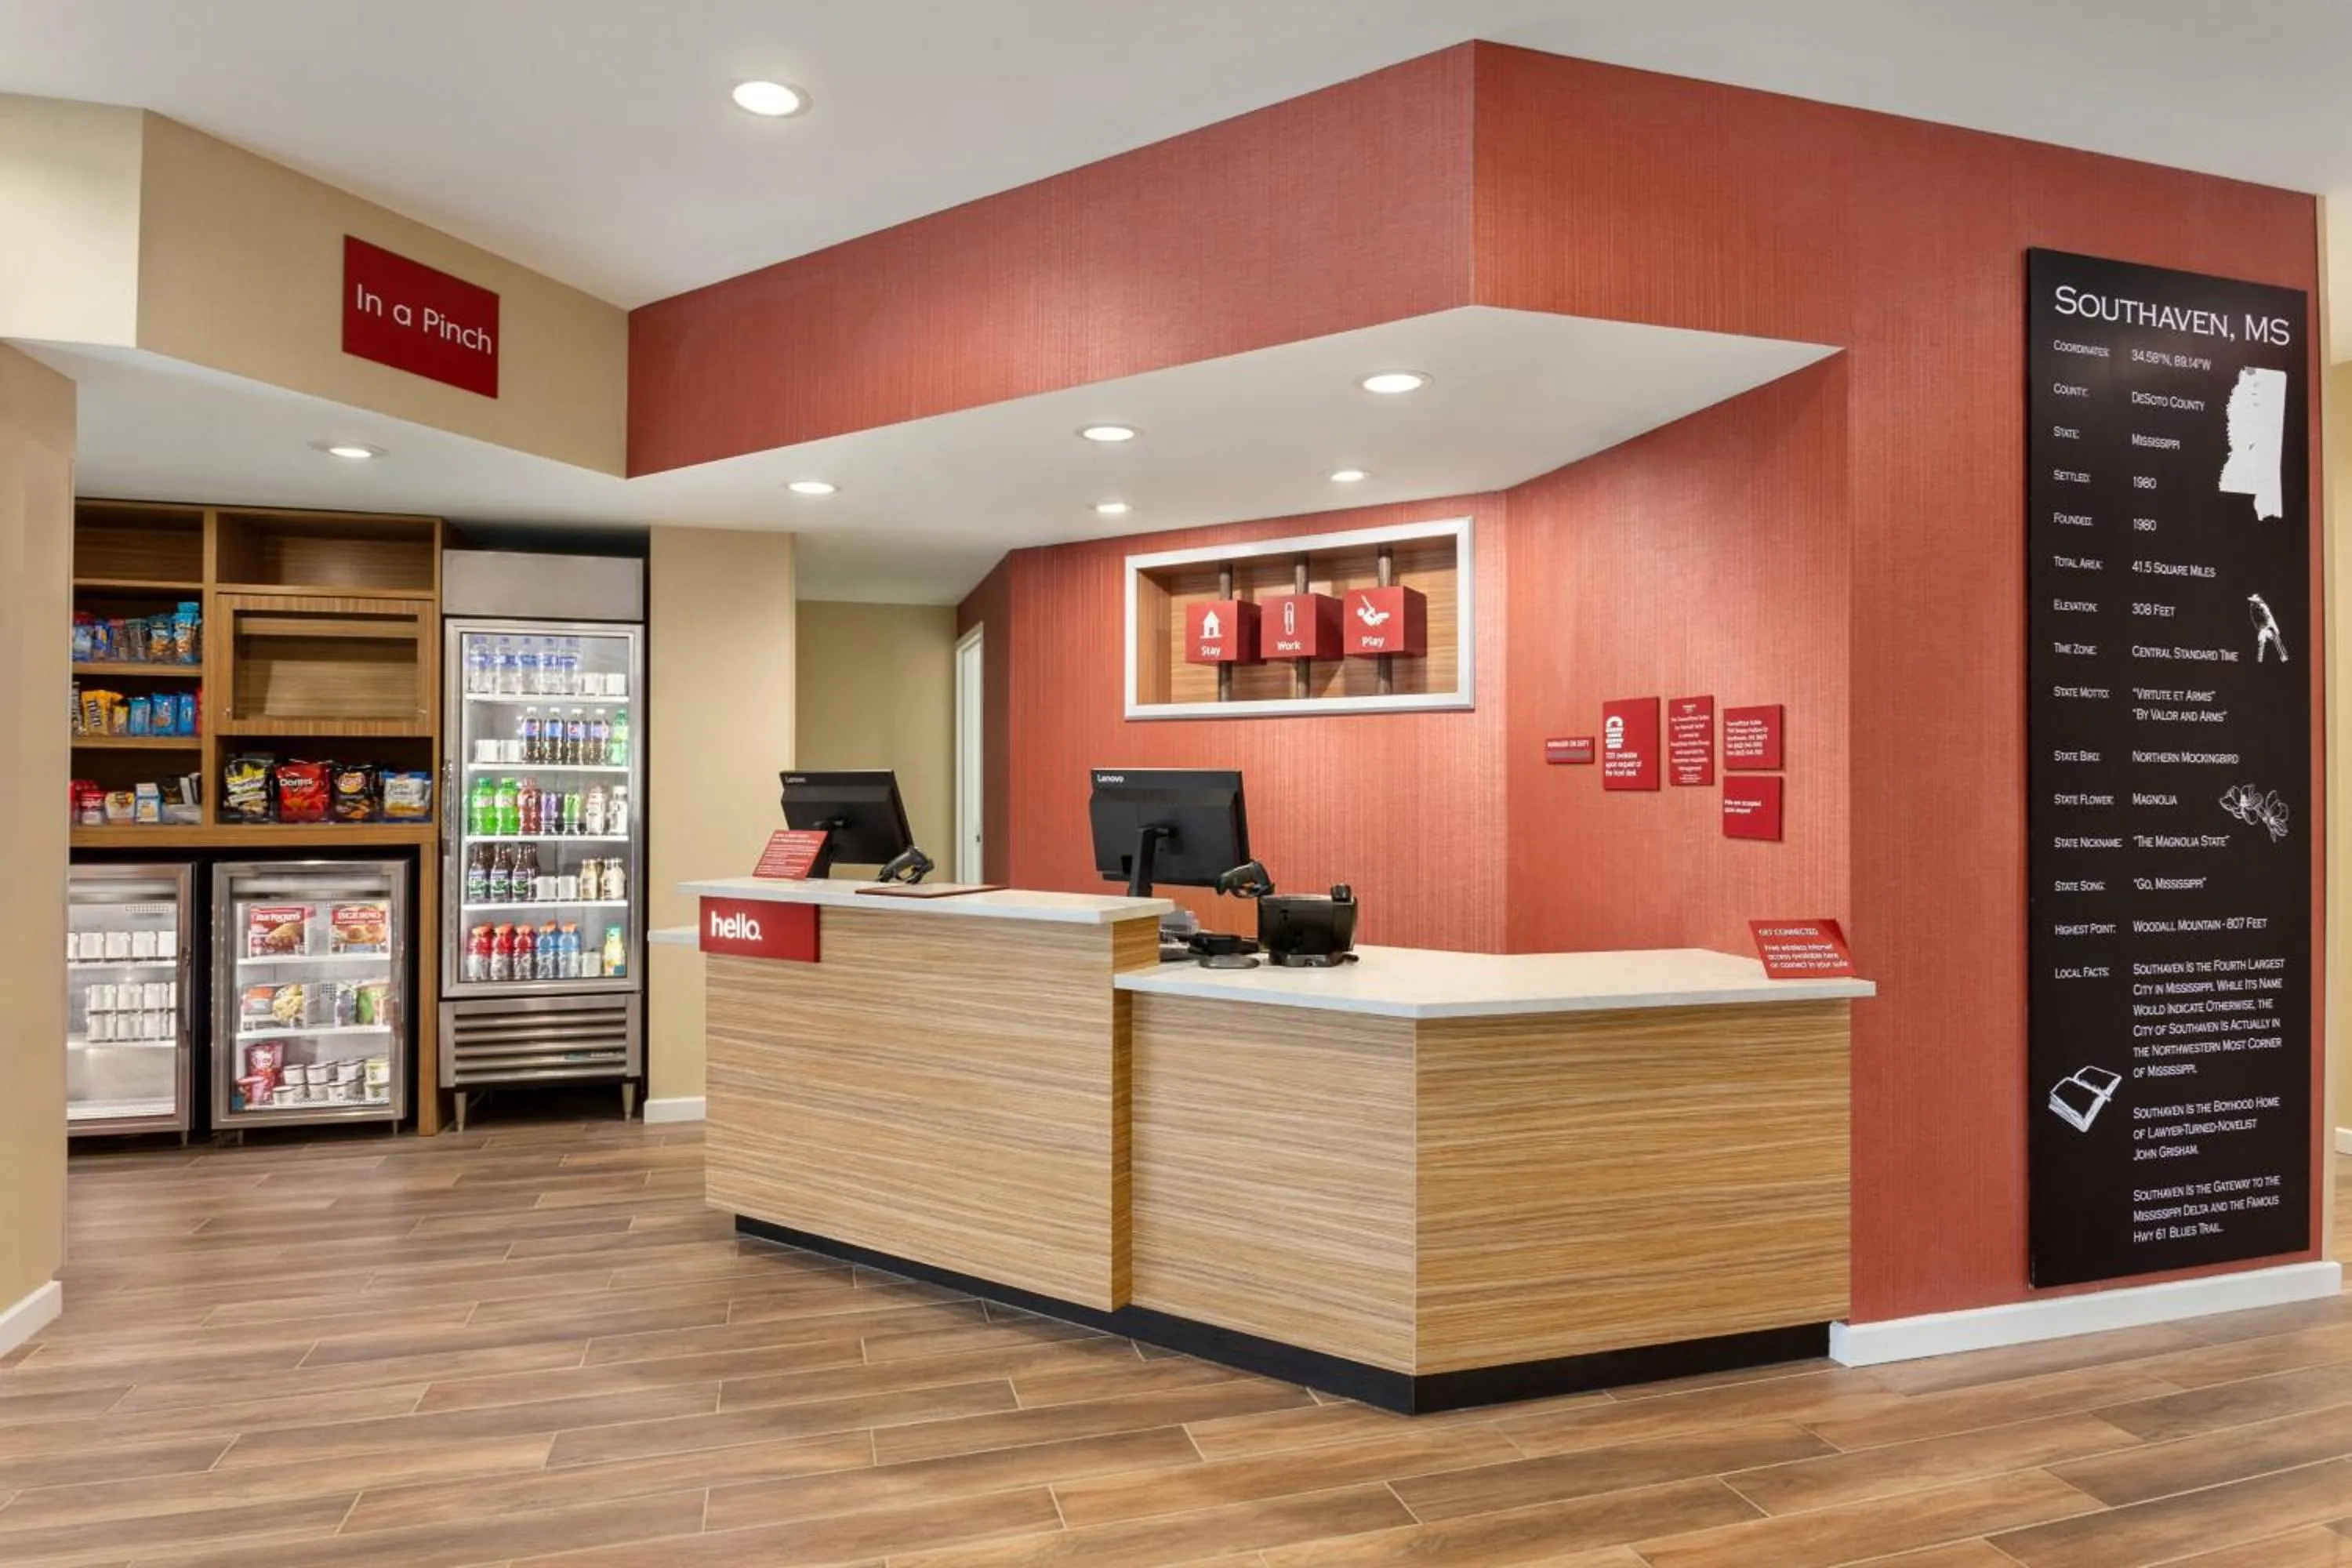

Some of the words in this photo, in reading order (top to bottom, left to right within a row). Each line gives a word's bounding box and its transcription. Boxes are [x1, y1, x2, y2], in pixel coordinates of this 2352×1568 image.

[358, 283, 382, 317] In
[393, 304, 412, 326] a
[423, 307, 492, 355] Pinch
[2054, 285, 2235, 343] SOUTHAVEN,
[2245, 314, 2290, 346] MS
[2170, 395, 2205, 411] COUNTY
[2053, 426, 2079, 439] STATE:
[2132, 434, 2180, 450] MISSISSIPPI
[2133, 477, 2156, 489] 1980
[2133, 518, 2156, 531] 1980
[2053, 556, 2080, 568] TOTAL
[2132, 561, 2151, 573] 41.5
[2154, 562, 2188, 575] SQUARE
[2190, 564, 2216, 577] MILES
[2054, 599, 2097, 612] ELEVATION:
[2132, 603, 2152, 615] 308
[2154, 604, 2175, 616] FEET
[1277, 641, 1301, 650] Work
[1362, 636, 1385, 648] Play
[2054, 643, 2071, 653] TIME
[1201, 645, 1221, 656] Stay
[2132, 645, 2172, 659] CENTRAL
[2174, 648, 2218, 660] STANDARD
[2220, 649, 2238, 662] TIME
[2054, 686, 2078, 696] STATE
[2173, 691, 2184, 701] ET
[2151, 709, 2179, 720] VALOR
[2180, 712, 2198, 721] AND
[2055, 750, 2078, 761] STATE
[2132, 751, 2180, 762] NORTHERN
[2181, 752, 2239, 764] MOCKINGBIRD
[1097, 774, 1124, 783] Lenovo
[2055, 794, 2078, 804] STATE
[2080, 794, 2114, 804] FLOWER:
[2132, 793, 2177, 804] MAGNOLIA
[2055, 837, 2078, 848] STATE
[2155, 835, 2199, 847] MAGNOLIA
[2055, 881, 2078, 891] STATE
[2081, 880, 2104, 891] SONG:
[710, 910, 762, 940] hello.
[2055, 925, 2089, 935] HIGHEST
[2090, 924, 2116, 934] POINT:
[2132, 920, 2176, 932] WOODALL
[2178, 920, 2221, 931] MOUNTAIN
[2227, 917, 2245, 929] 807
[2247, 917, 2267, 928] FEET
[2056, 968, 2082, 978] LOCAL
[2083, 967, 2109, 977] FACTS:
[2133, 964, 2184, 975] SOUTHAVEN
[2186, 961, 2194, 972] IS
[2195, 962, 2212, 971] THE
[2214, 960, 2246, 971] FOURTH
[2249, 959, 2285, 970] LARGEST
[2133, 984, 2153, 996] CITY
[2155, 985, 2164, 994] IN
[2217, 980, 2243, 991] WHILE
[2245, 978, 2258, 989] ITS
[2259, 978, 2282, 988] NAME
[2132, 1005, 2165, 1016] WOULD
[2167, 1002, 2205, 1014] INDICATE
[2258, 999, 2273, 1008] THE
[2133, 1025, 2153, 1036] CITY
[2154, 1025, 2167, 1035] OF
[2169, 1022, 2219, 1034] SOUTHAVEN
[2220, 1021, 2229, 1031] IS
[2230, 1019, 2270, 1030] ACTUALLY
[2272, 1018, 2280, 1027] IN
[2133, 1047, 2150, 1057] THE
[2152, 1042, 2220, 1056] NORTHWESTERN
[2223, 1040, 2246, 1051] MOST
[2248, 1037, 2281, 1049] CORNER
[2133, 1068, 2145, 1077] OF
[2133, 1105, 2184, 1119] SOUTHAVEN
[2186, 1104, 2194, 1114] IS
[2195, 1103, 2212, 1113] THE
[2214, 1098, 2254, 1112] BOYHOOD
[2256, 1097, 2280, 1107] HOME
[2133, 1129, 2145, 1139] OF
[2133, 1149, 2157, 1160] JOHN
[2159, 1145, 2198, 1157] GRISHAM.
[2134, 1187, 2184, 1201] SOUTHAVEN
[2186, 1185, 2194, 1195] IS
[2195, 1184, 2212, 1193] THE
[2213, 1179, 2251, 1192] GATEWAY
[2252, 1178, 2263, 1187] TO
[2264, 1176, 2280, 1185] THE
[2134, 1207, 2181, 1222] MISSISSIPPI
[2183, 1204, 2209, 1216] DELTA
[2211, 1202, 2227, 1212] AND
[2229, 1200, 2245, 1210] THE
[2247, 1196, 2279, 1207] FAMOUS
[2134, 1231, 2153, 1242] HWY
[2156, 1228, 2165, 1240] 61
[2169, 1226, 2197, 1238] BLUES
